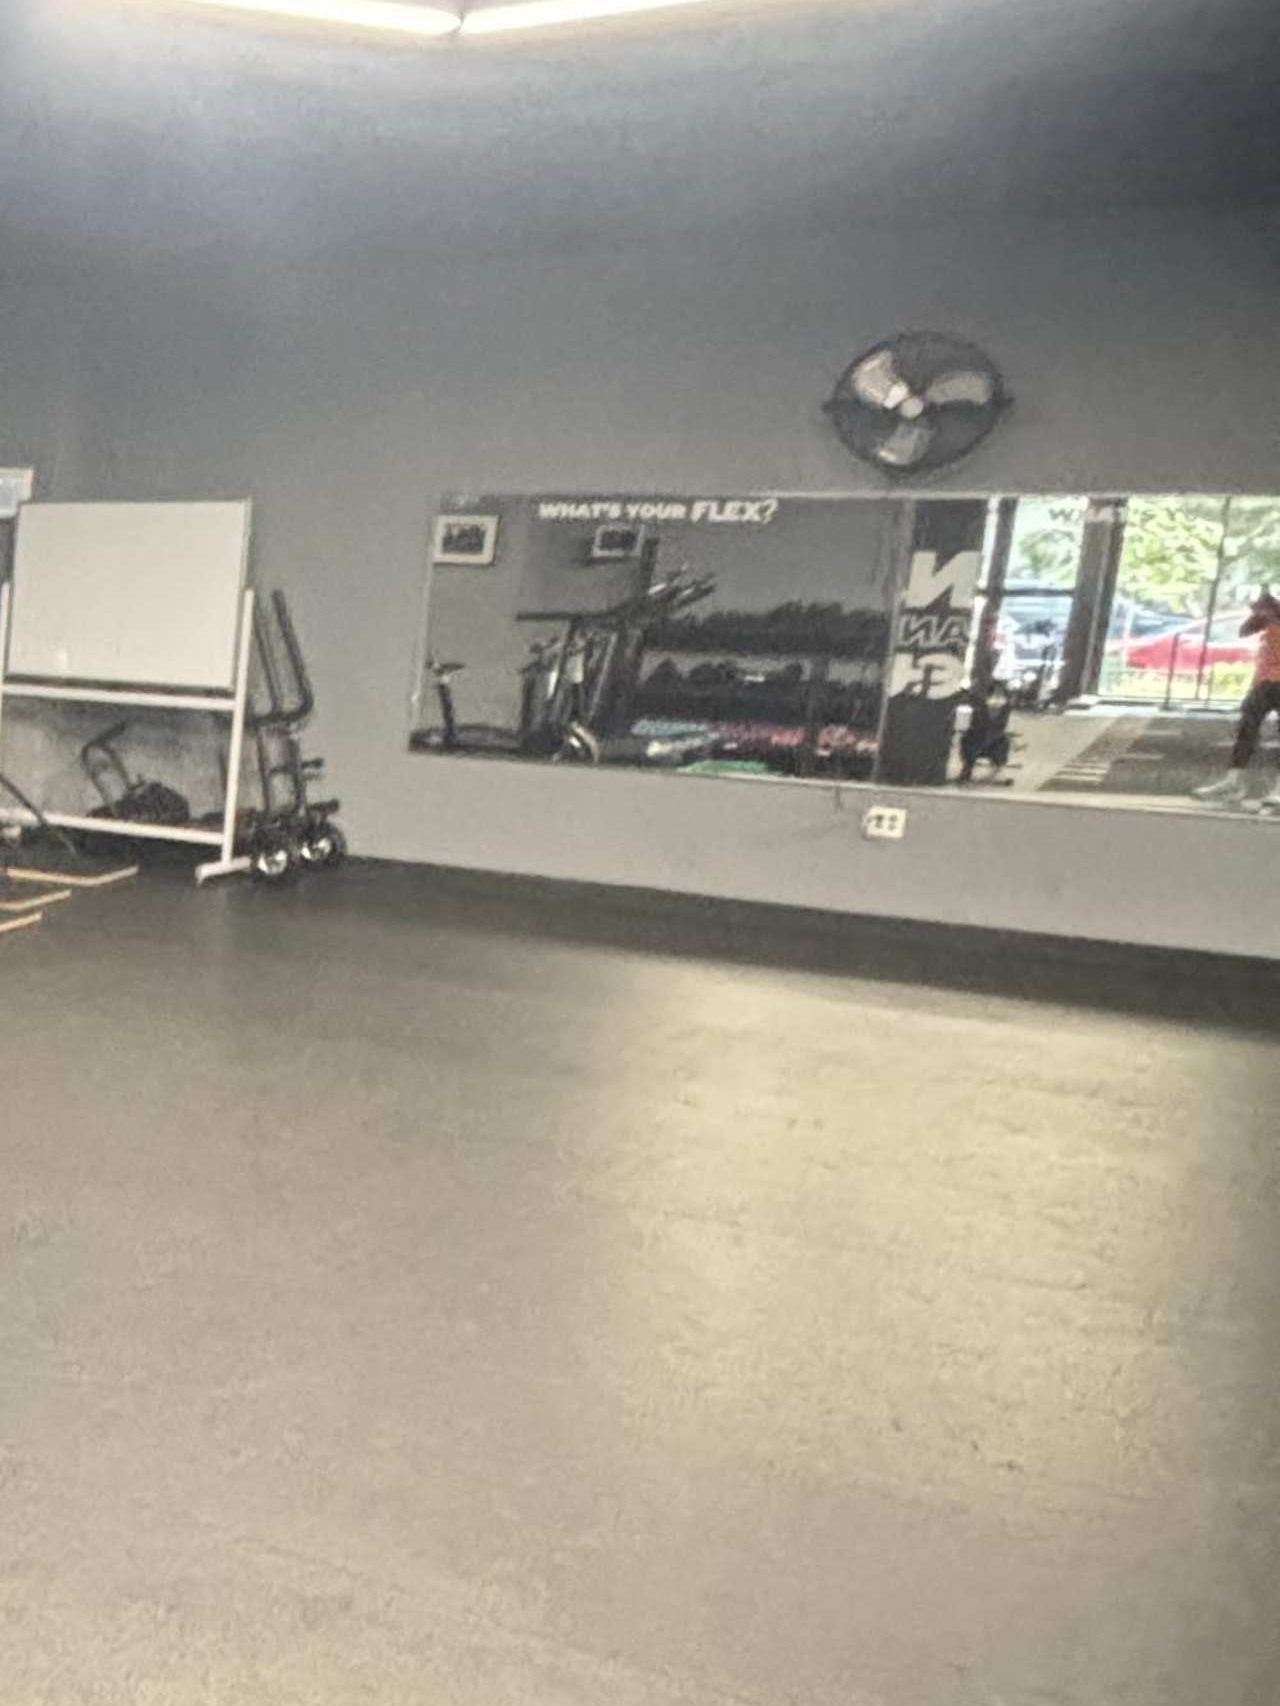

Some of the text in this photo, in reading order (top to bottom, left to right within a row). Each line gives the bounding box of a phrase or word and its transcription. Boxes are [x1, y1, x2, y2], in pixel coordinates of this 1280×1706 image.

[539, 497, 779, 524] WHAT'S YOUR FLEX?
